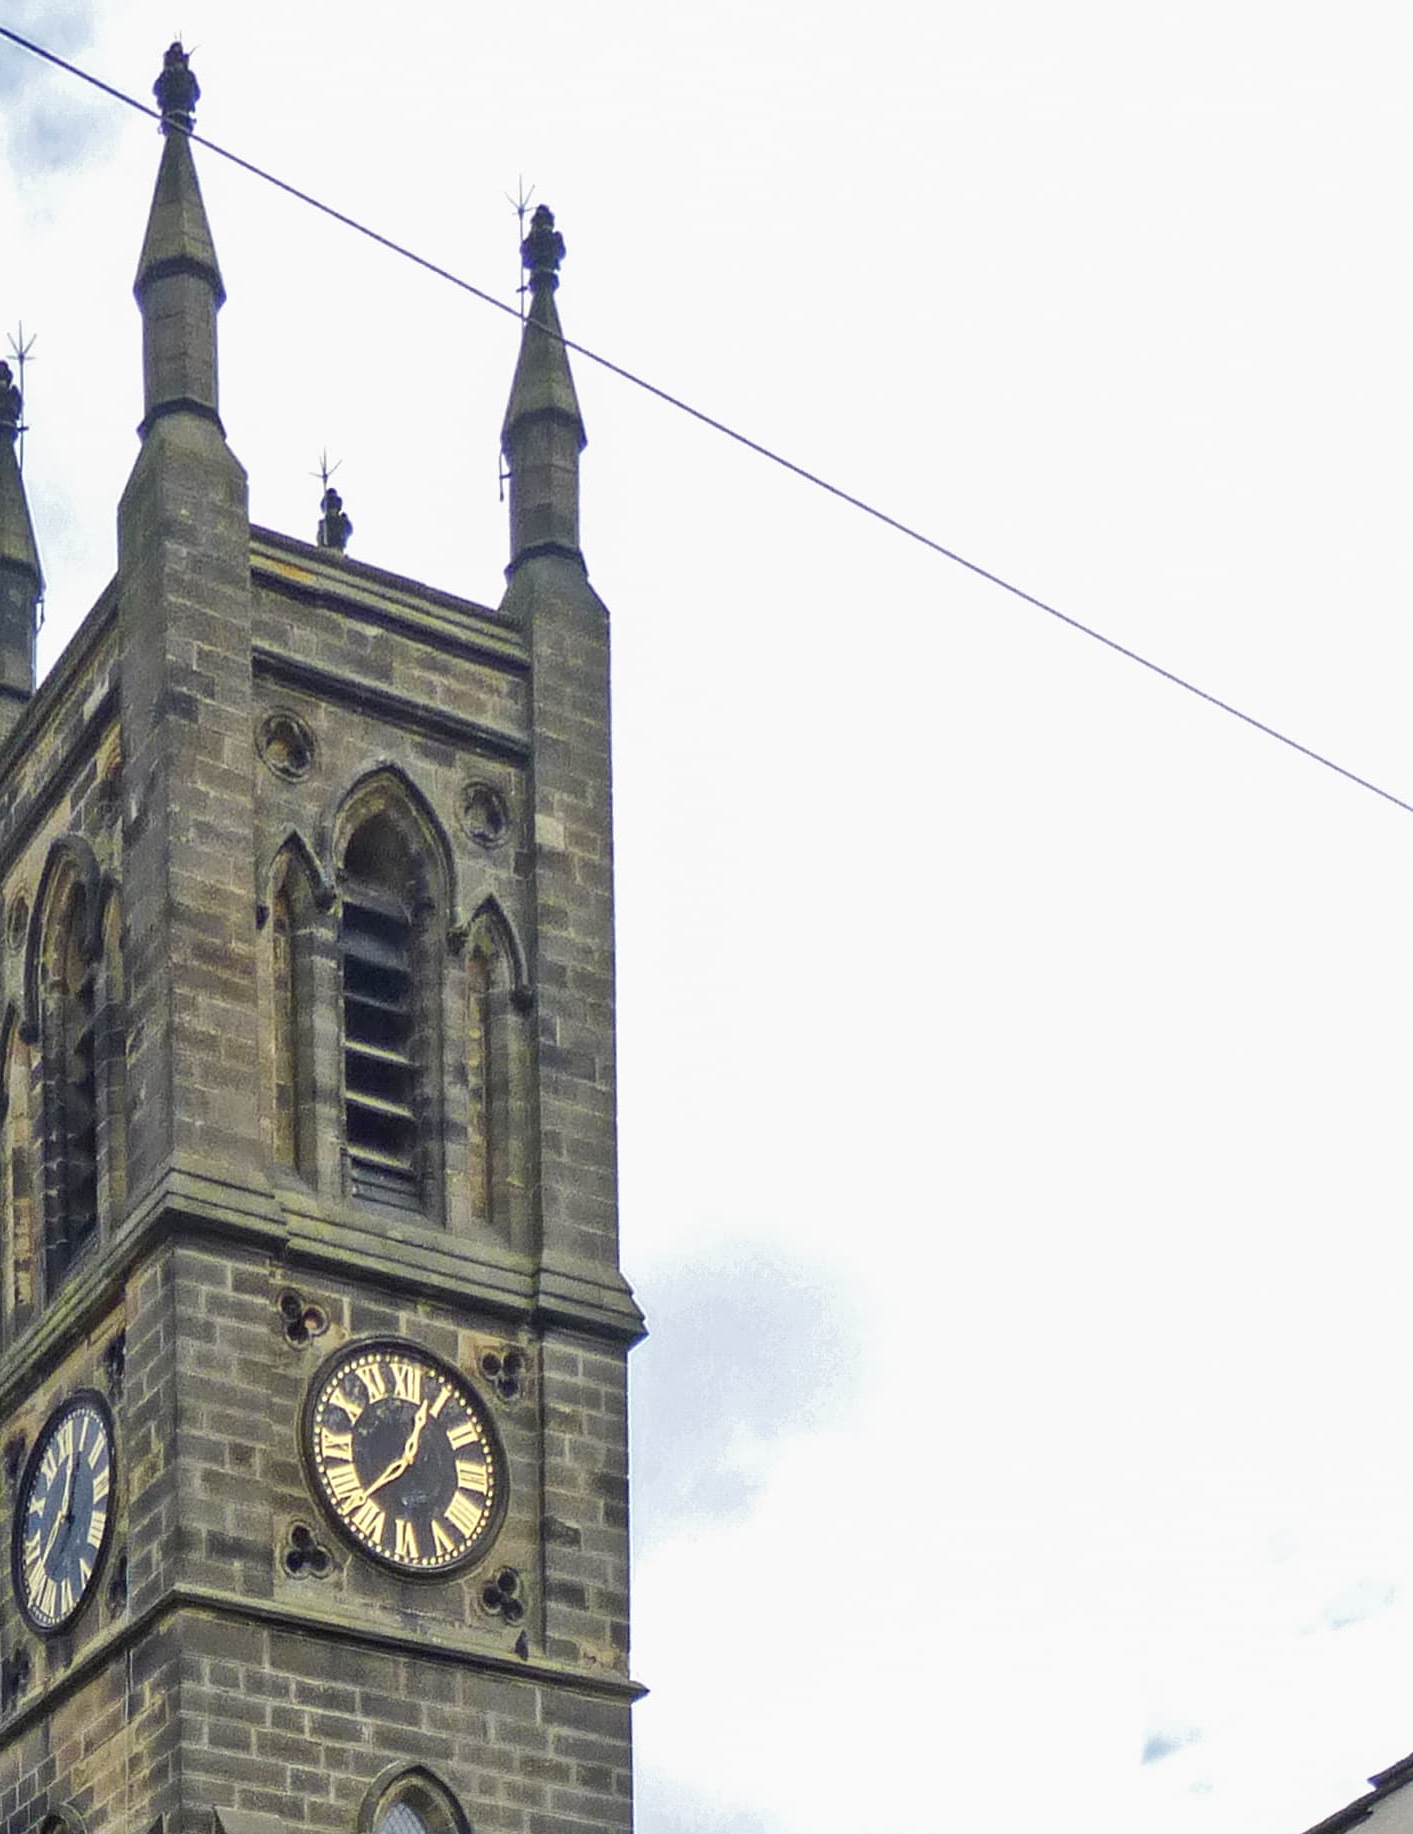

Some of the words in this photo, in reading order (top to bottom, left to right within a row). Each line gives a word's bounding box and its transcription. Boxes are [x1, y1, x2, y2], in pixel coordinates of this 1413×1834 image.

[355, 1363, 387, 1404] XI
[389, 1362, 422, 1405] XII
[429, 1387, 451, 1418] I
[329, 1387, 364, 1425] X
[321, 1427, 353, 1462] IX
[446, 1421, 479, 1450] II
[455, 1460, 488, 1496] III
[395, 1518, 419, 1558] VI
[431, 1519, 455, 1557] V
